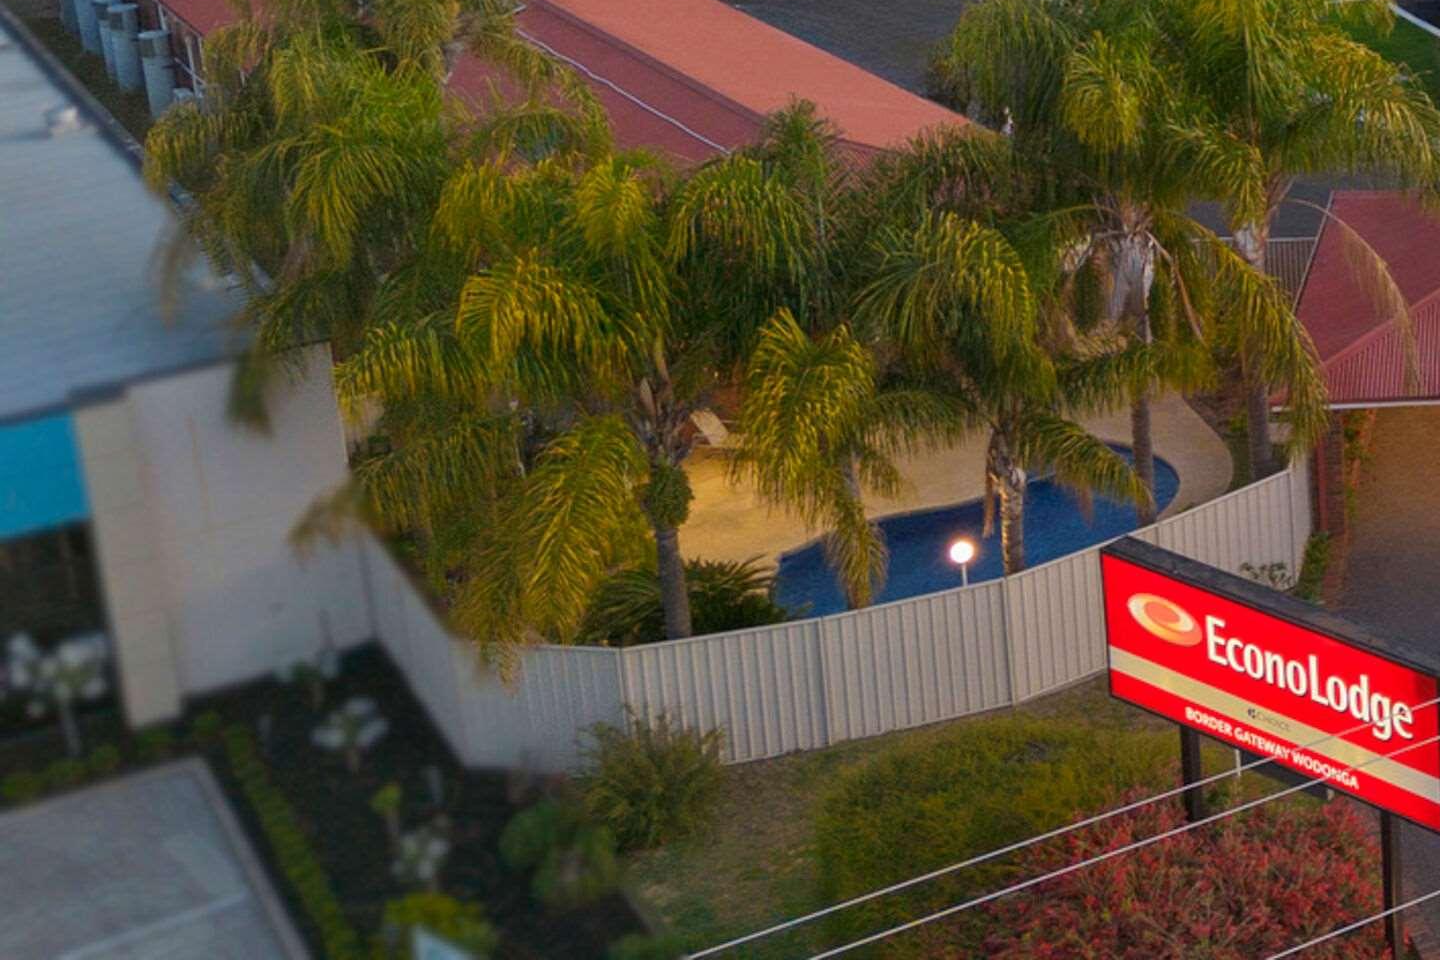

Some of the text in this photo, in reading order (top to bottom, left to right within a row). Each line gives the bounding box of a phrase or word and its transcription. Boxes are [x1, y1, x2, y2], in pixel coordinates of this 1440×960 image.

[1205, 615, 1414, 740] EconoLodge
[1185, 707, 1360, 790] BORDER GATEWAY WODONGA
